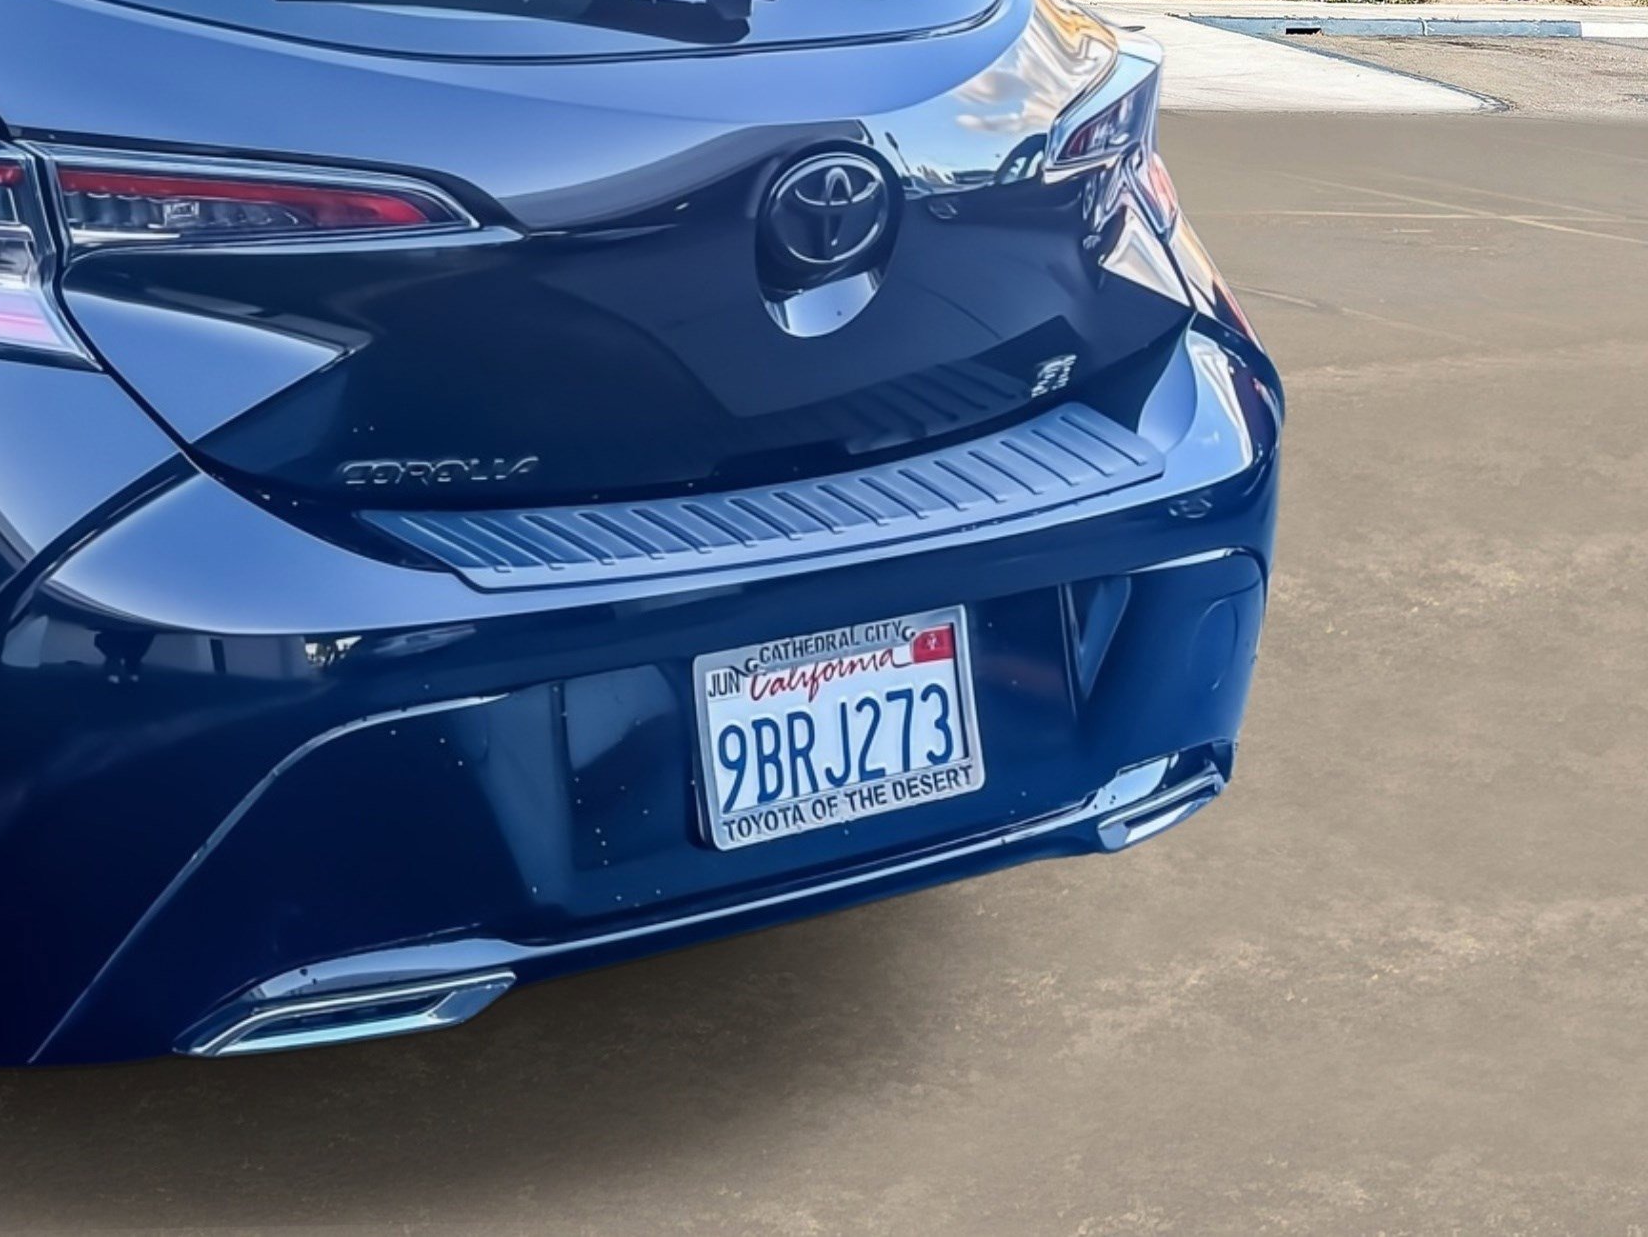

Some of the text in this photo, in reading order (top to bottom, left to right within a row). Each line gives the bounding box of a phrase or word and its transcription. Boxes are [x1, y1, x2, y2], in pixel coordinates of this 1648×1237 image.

[758, 620, 902, 664] CATHEDRAL CITY
[708, 666, 741, 698] JUN
[750, 648, 912, 703] California
[717, 682, 954, 813] 9BRJ273
[722, 764, 974, 842] TOYOTA OF THE DESERT
